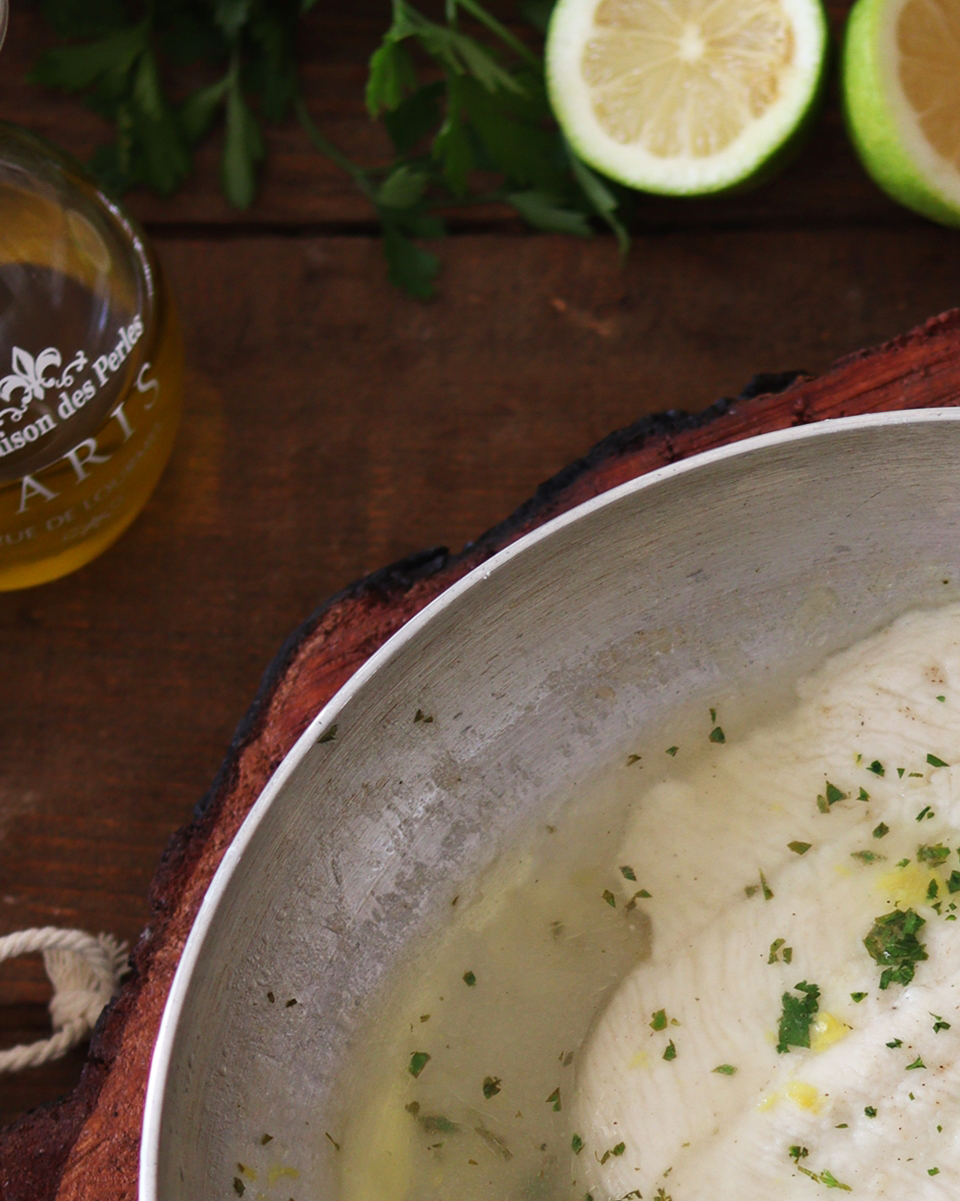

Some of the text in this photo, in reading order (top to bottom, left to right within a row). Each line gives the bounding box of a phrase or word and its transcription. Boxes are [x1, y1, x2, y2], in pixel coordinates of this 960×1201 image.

[0, 313, 145, 457] ison des Perles
